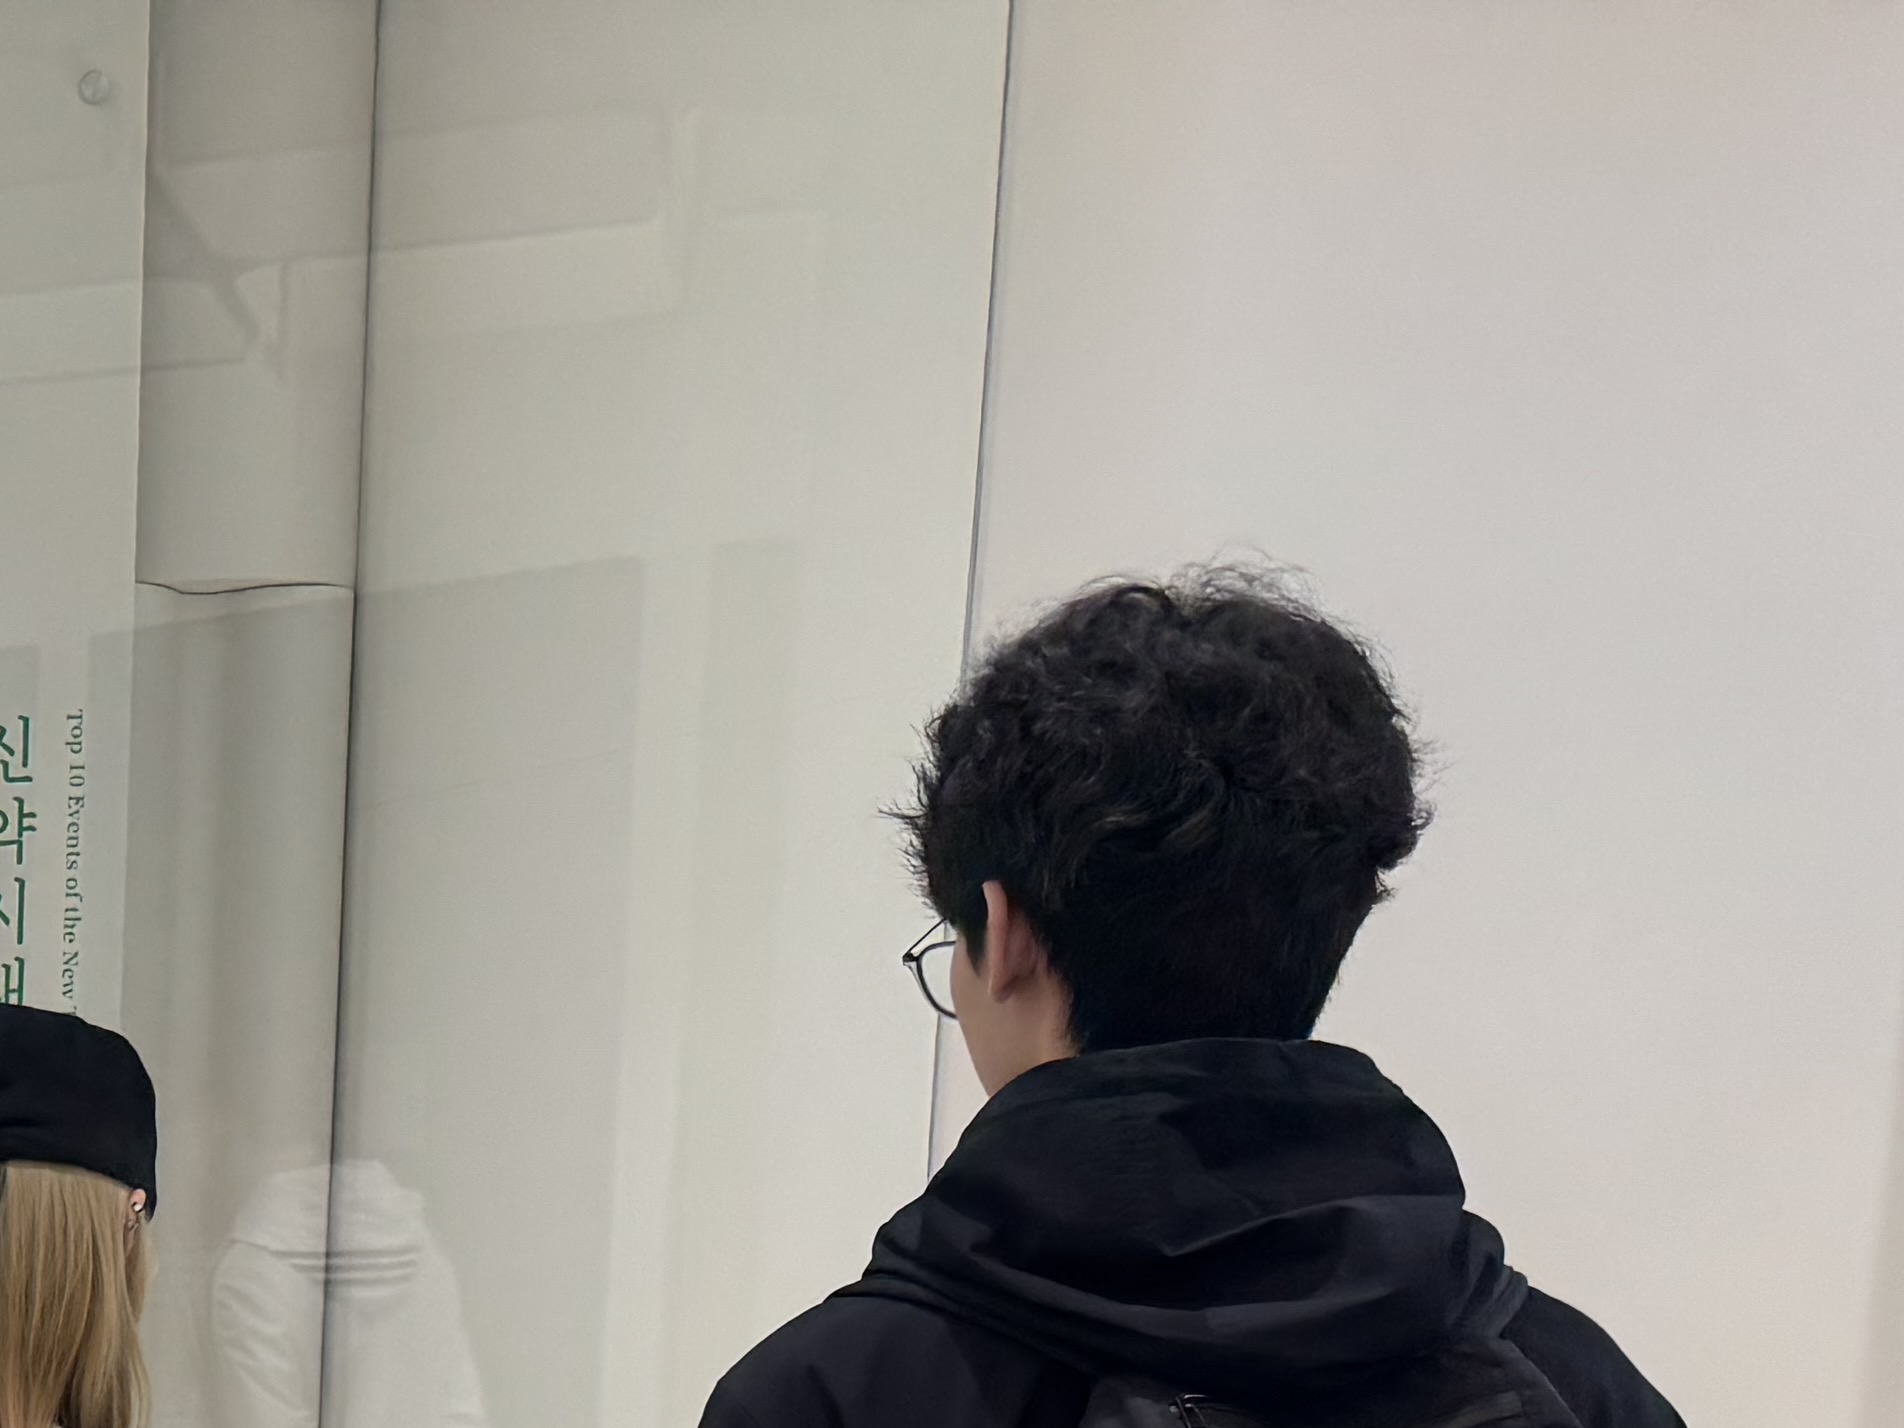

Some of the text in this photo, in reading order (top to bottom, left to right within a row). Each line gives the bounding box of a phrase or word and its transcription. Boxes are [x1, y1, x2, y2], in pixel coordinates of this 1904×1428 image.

[64, 708, 84, 755] Top
[68, 764, 86, 788] 10
[65, 795, 86, 871] Events
[64, 877, 84, 903] of
[62, 907, 82, 944] the
[61, 951, 79, 999] New
